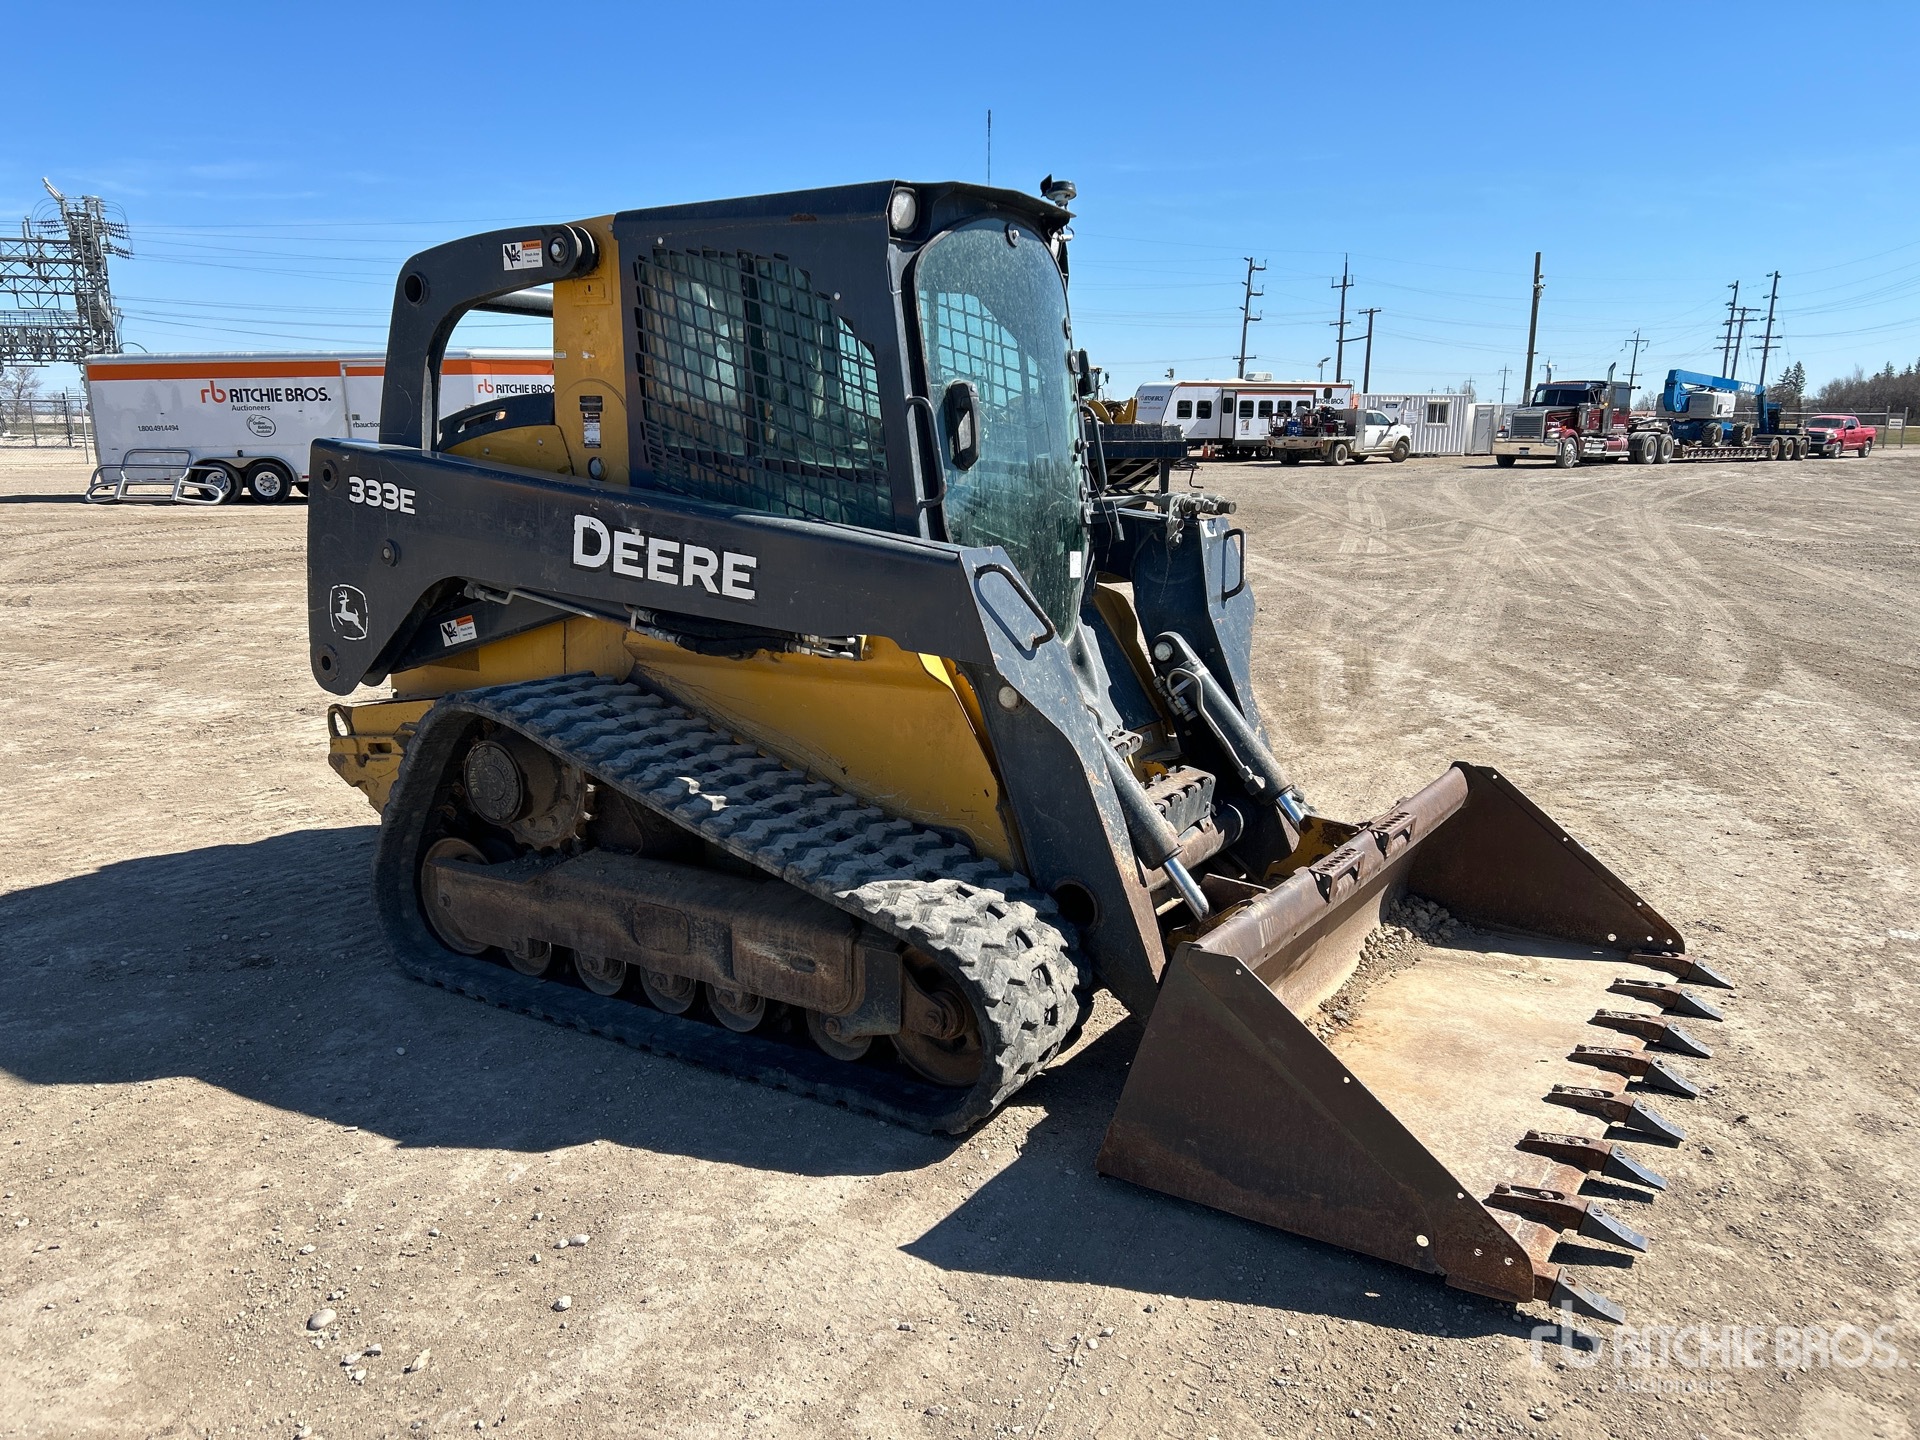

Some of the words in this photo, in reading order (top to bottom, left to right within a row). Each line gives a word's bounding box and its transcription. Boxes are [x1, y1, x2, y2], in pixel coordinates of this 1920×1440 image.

[229, 388, 283, 403] RITCHIE
[285, 387, 332, 402] BROS.
[495, 384, 530, 394] RITCHIE
[531, 384, 555, 394] BRO
[232, 404, 271, 412] Auctioneers
[348, 476, 416, 515] 333E
[573, 514, 757, 600] DEERE
